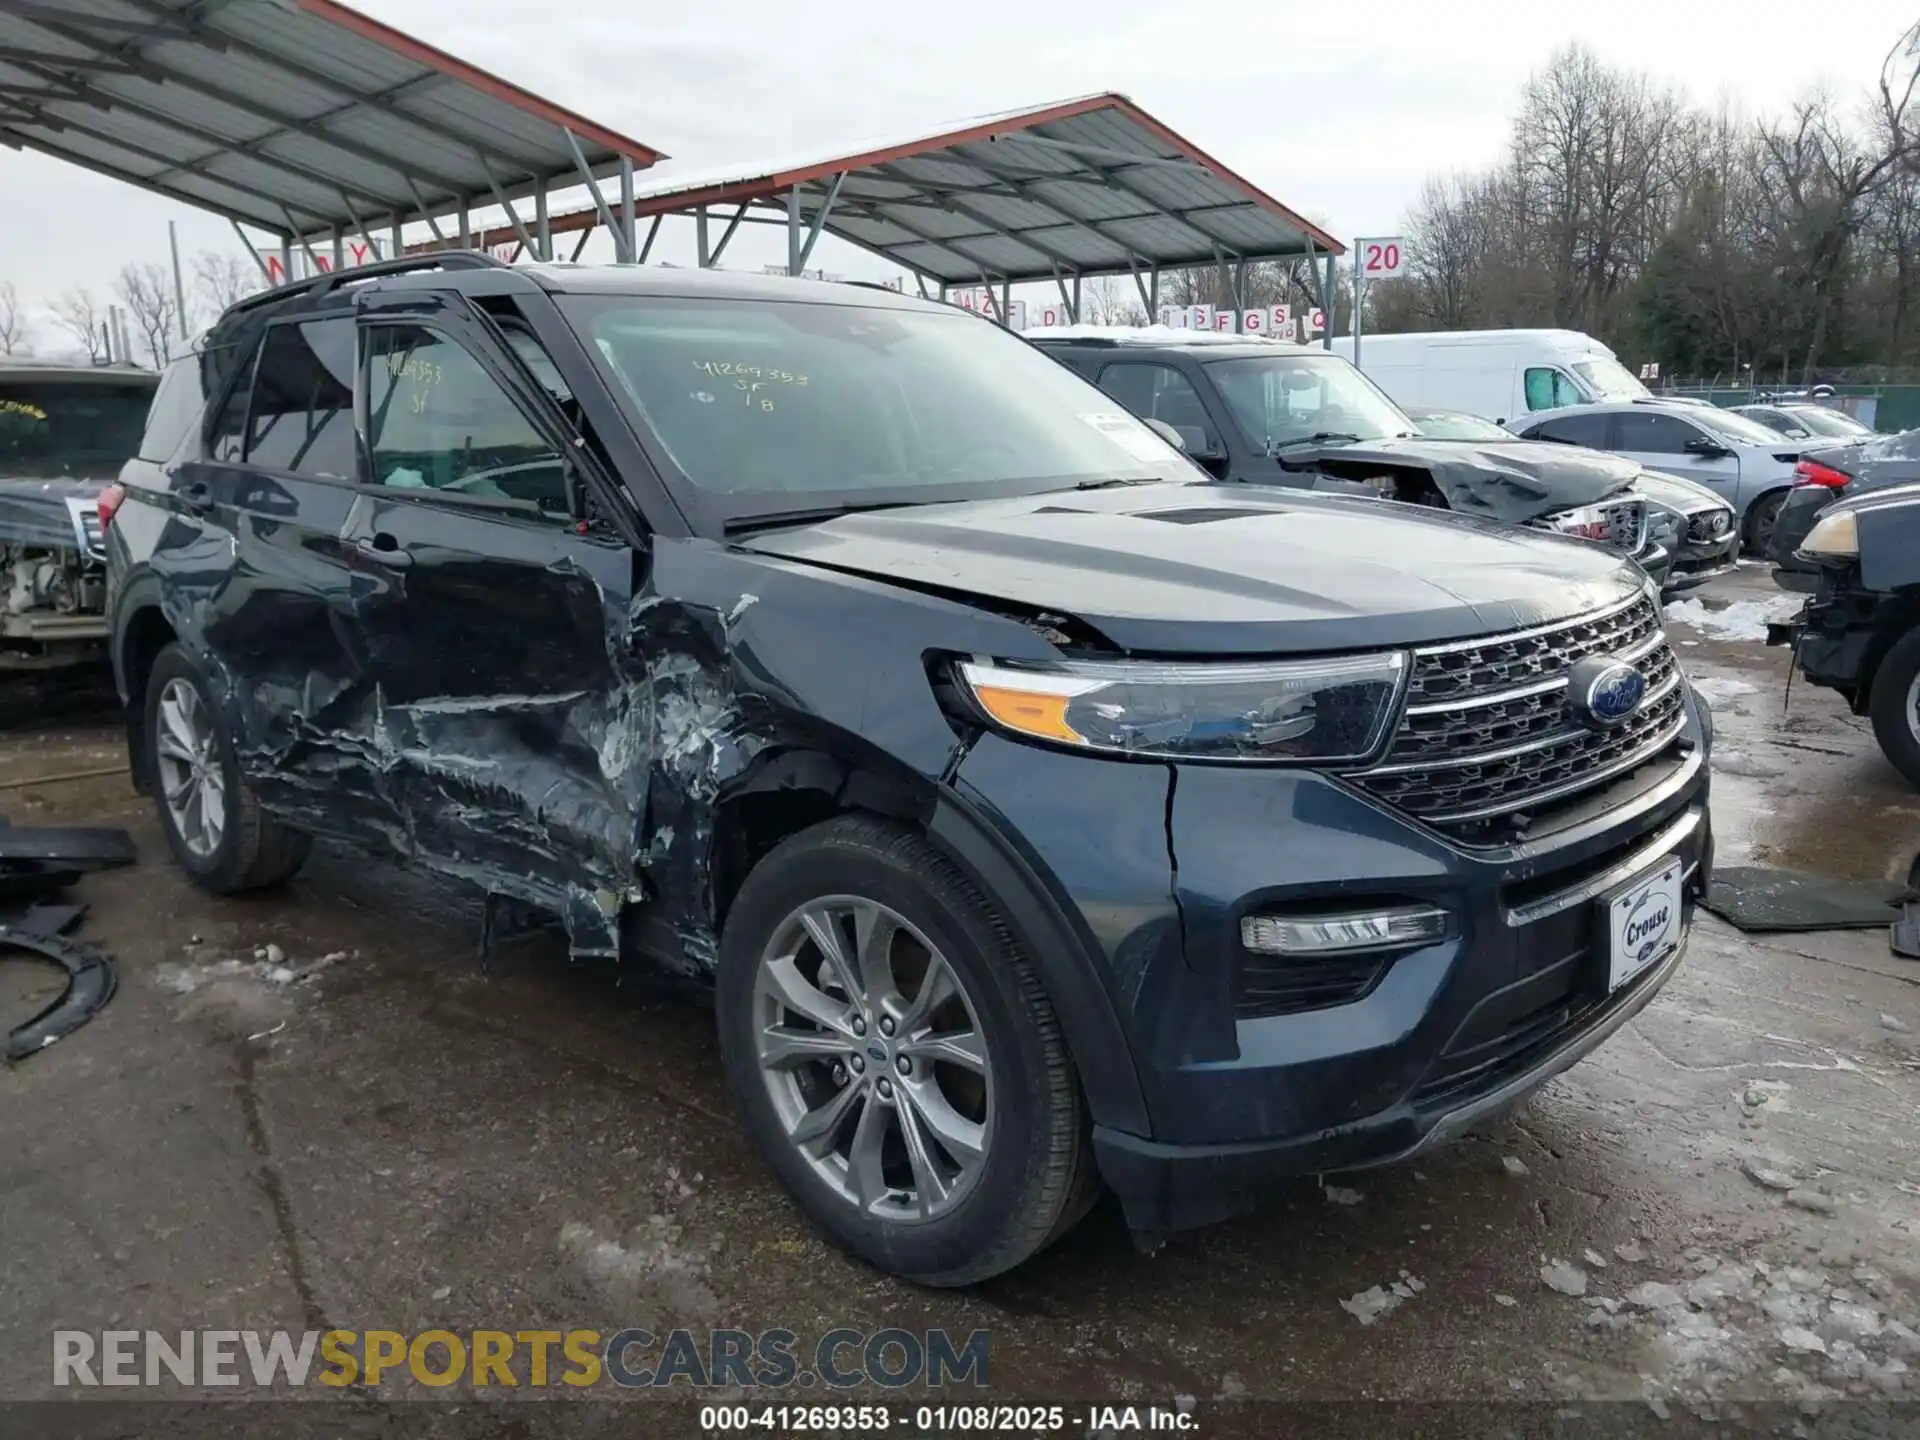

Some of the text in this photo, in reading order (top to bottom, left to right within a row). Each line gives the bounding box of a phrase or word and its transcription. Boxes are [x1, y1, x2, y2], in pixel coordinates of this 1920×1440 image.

[1367, 244, 1399, 271] 20
[1044, 310, 1056, 326] D
[1218, 315, 1229, 331] F
[1245, 314, 1260, 330] G
[1275, 308, 1286, 324] S
[1313, 312, 1328, 328] Q
[1606, 678, 1638, 710] Ford
[1626, 906, 1669, 947] Crouse
